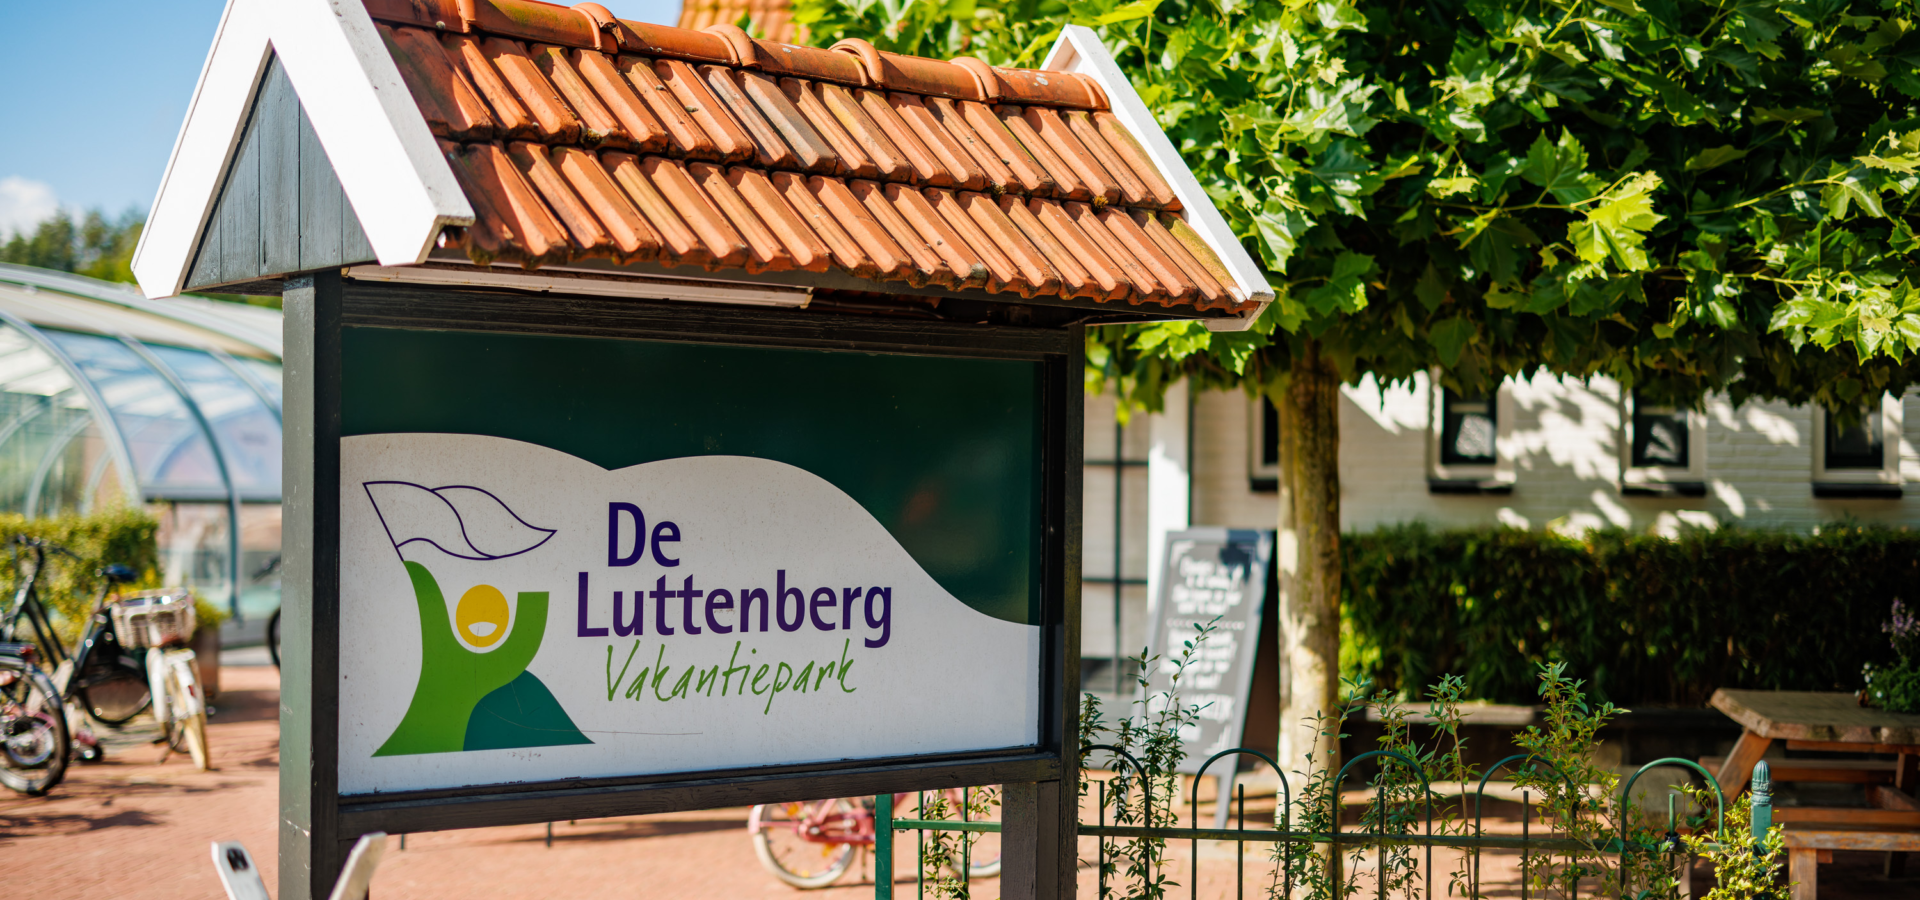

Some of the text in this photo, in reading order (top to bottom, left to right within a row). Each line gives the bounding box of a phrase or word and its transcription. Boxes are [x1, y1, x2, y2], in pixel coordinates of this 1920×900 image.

[608, 501, 681, 567] De
[577, 569, 892, 648] Luttenberg
[606, 638, 857, 715] Vakantiepark
